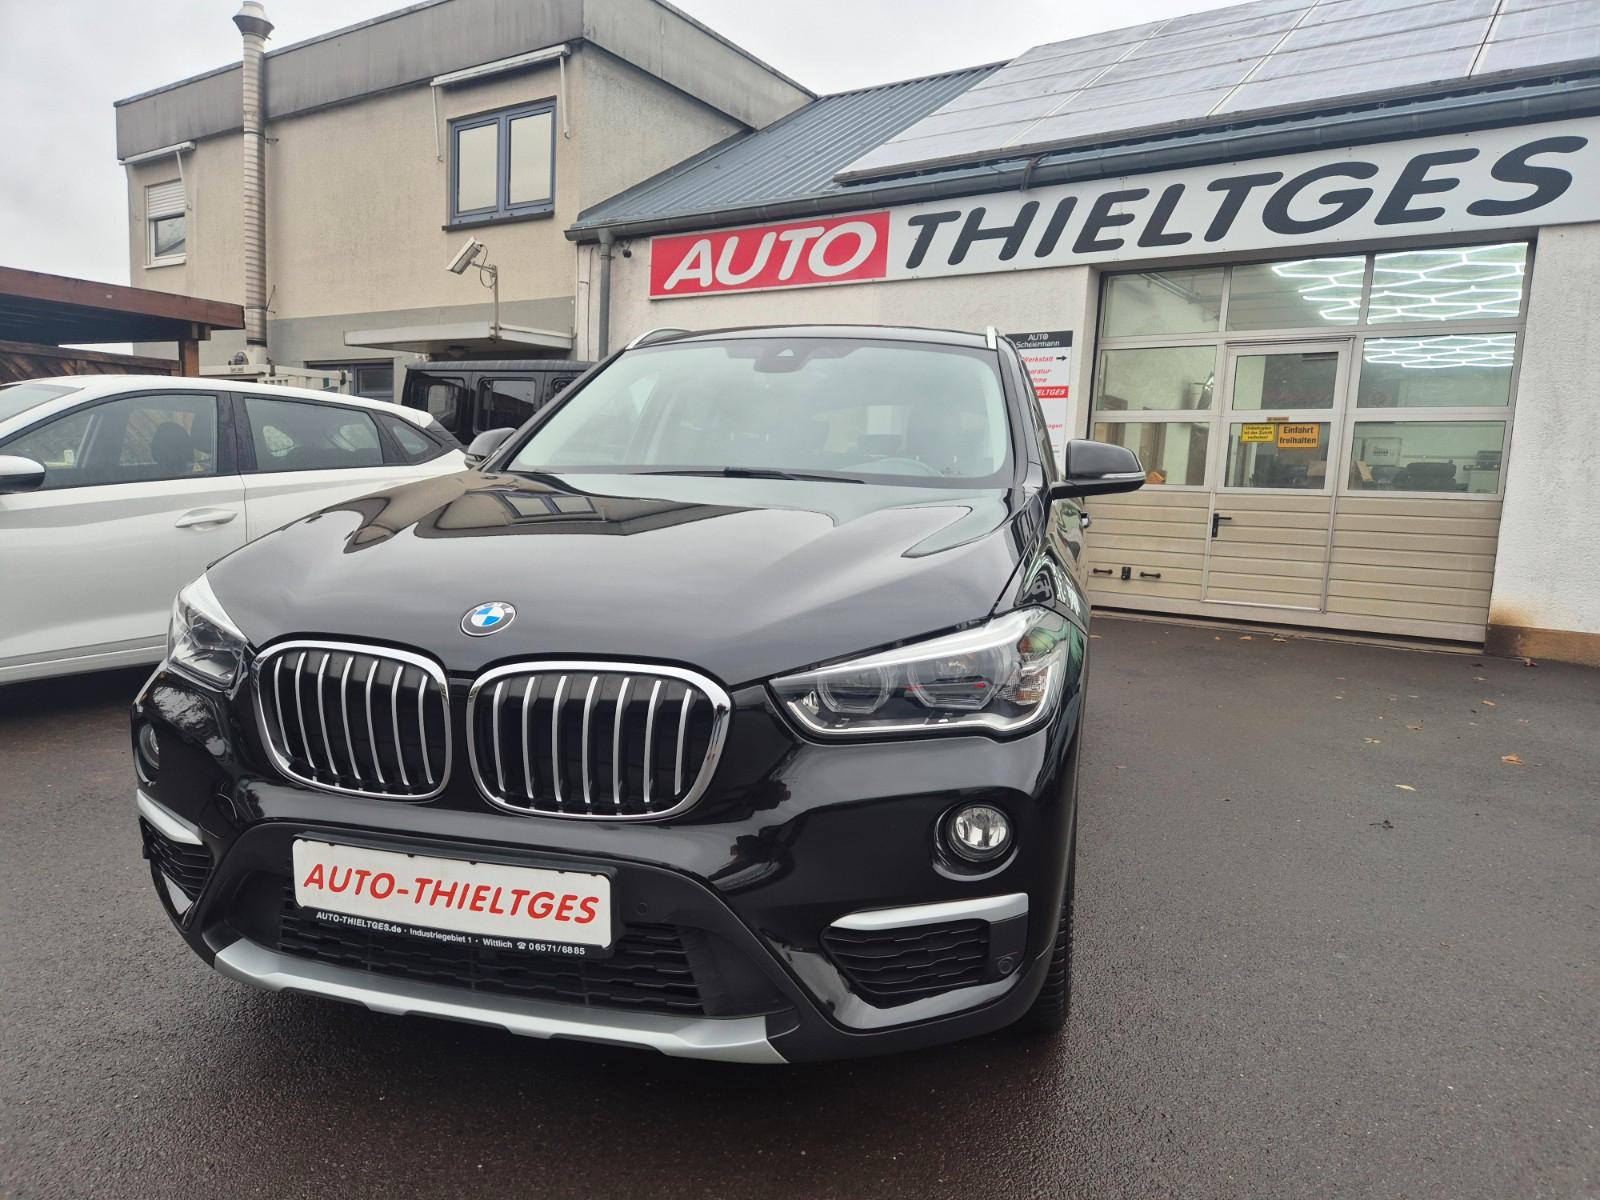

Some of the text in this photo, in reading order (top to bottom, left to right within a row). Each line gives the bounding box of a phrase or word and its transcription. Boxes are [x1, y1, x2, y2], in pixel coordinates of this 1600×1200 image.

[663, 136, 1588, 290] AUTO THIELTGES
[1036, 388, 1066, 396] ELTGES
[1283, 426, 1314, 434] Einfahrt
[303, 863, 600, 924] AUTO-THIELTGES
[316, 911, 402, 933] AUTO-THIELTGES.de
[409, 928, 466, 943] Industriegebiet
[482, 938, 513, 949] Wittlich
